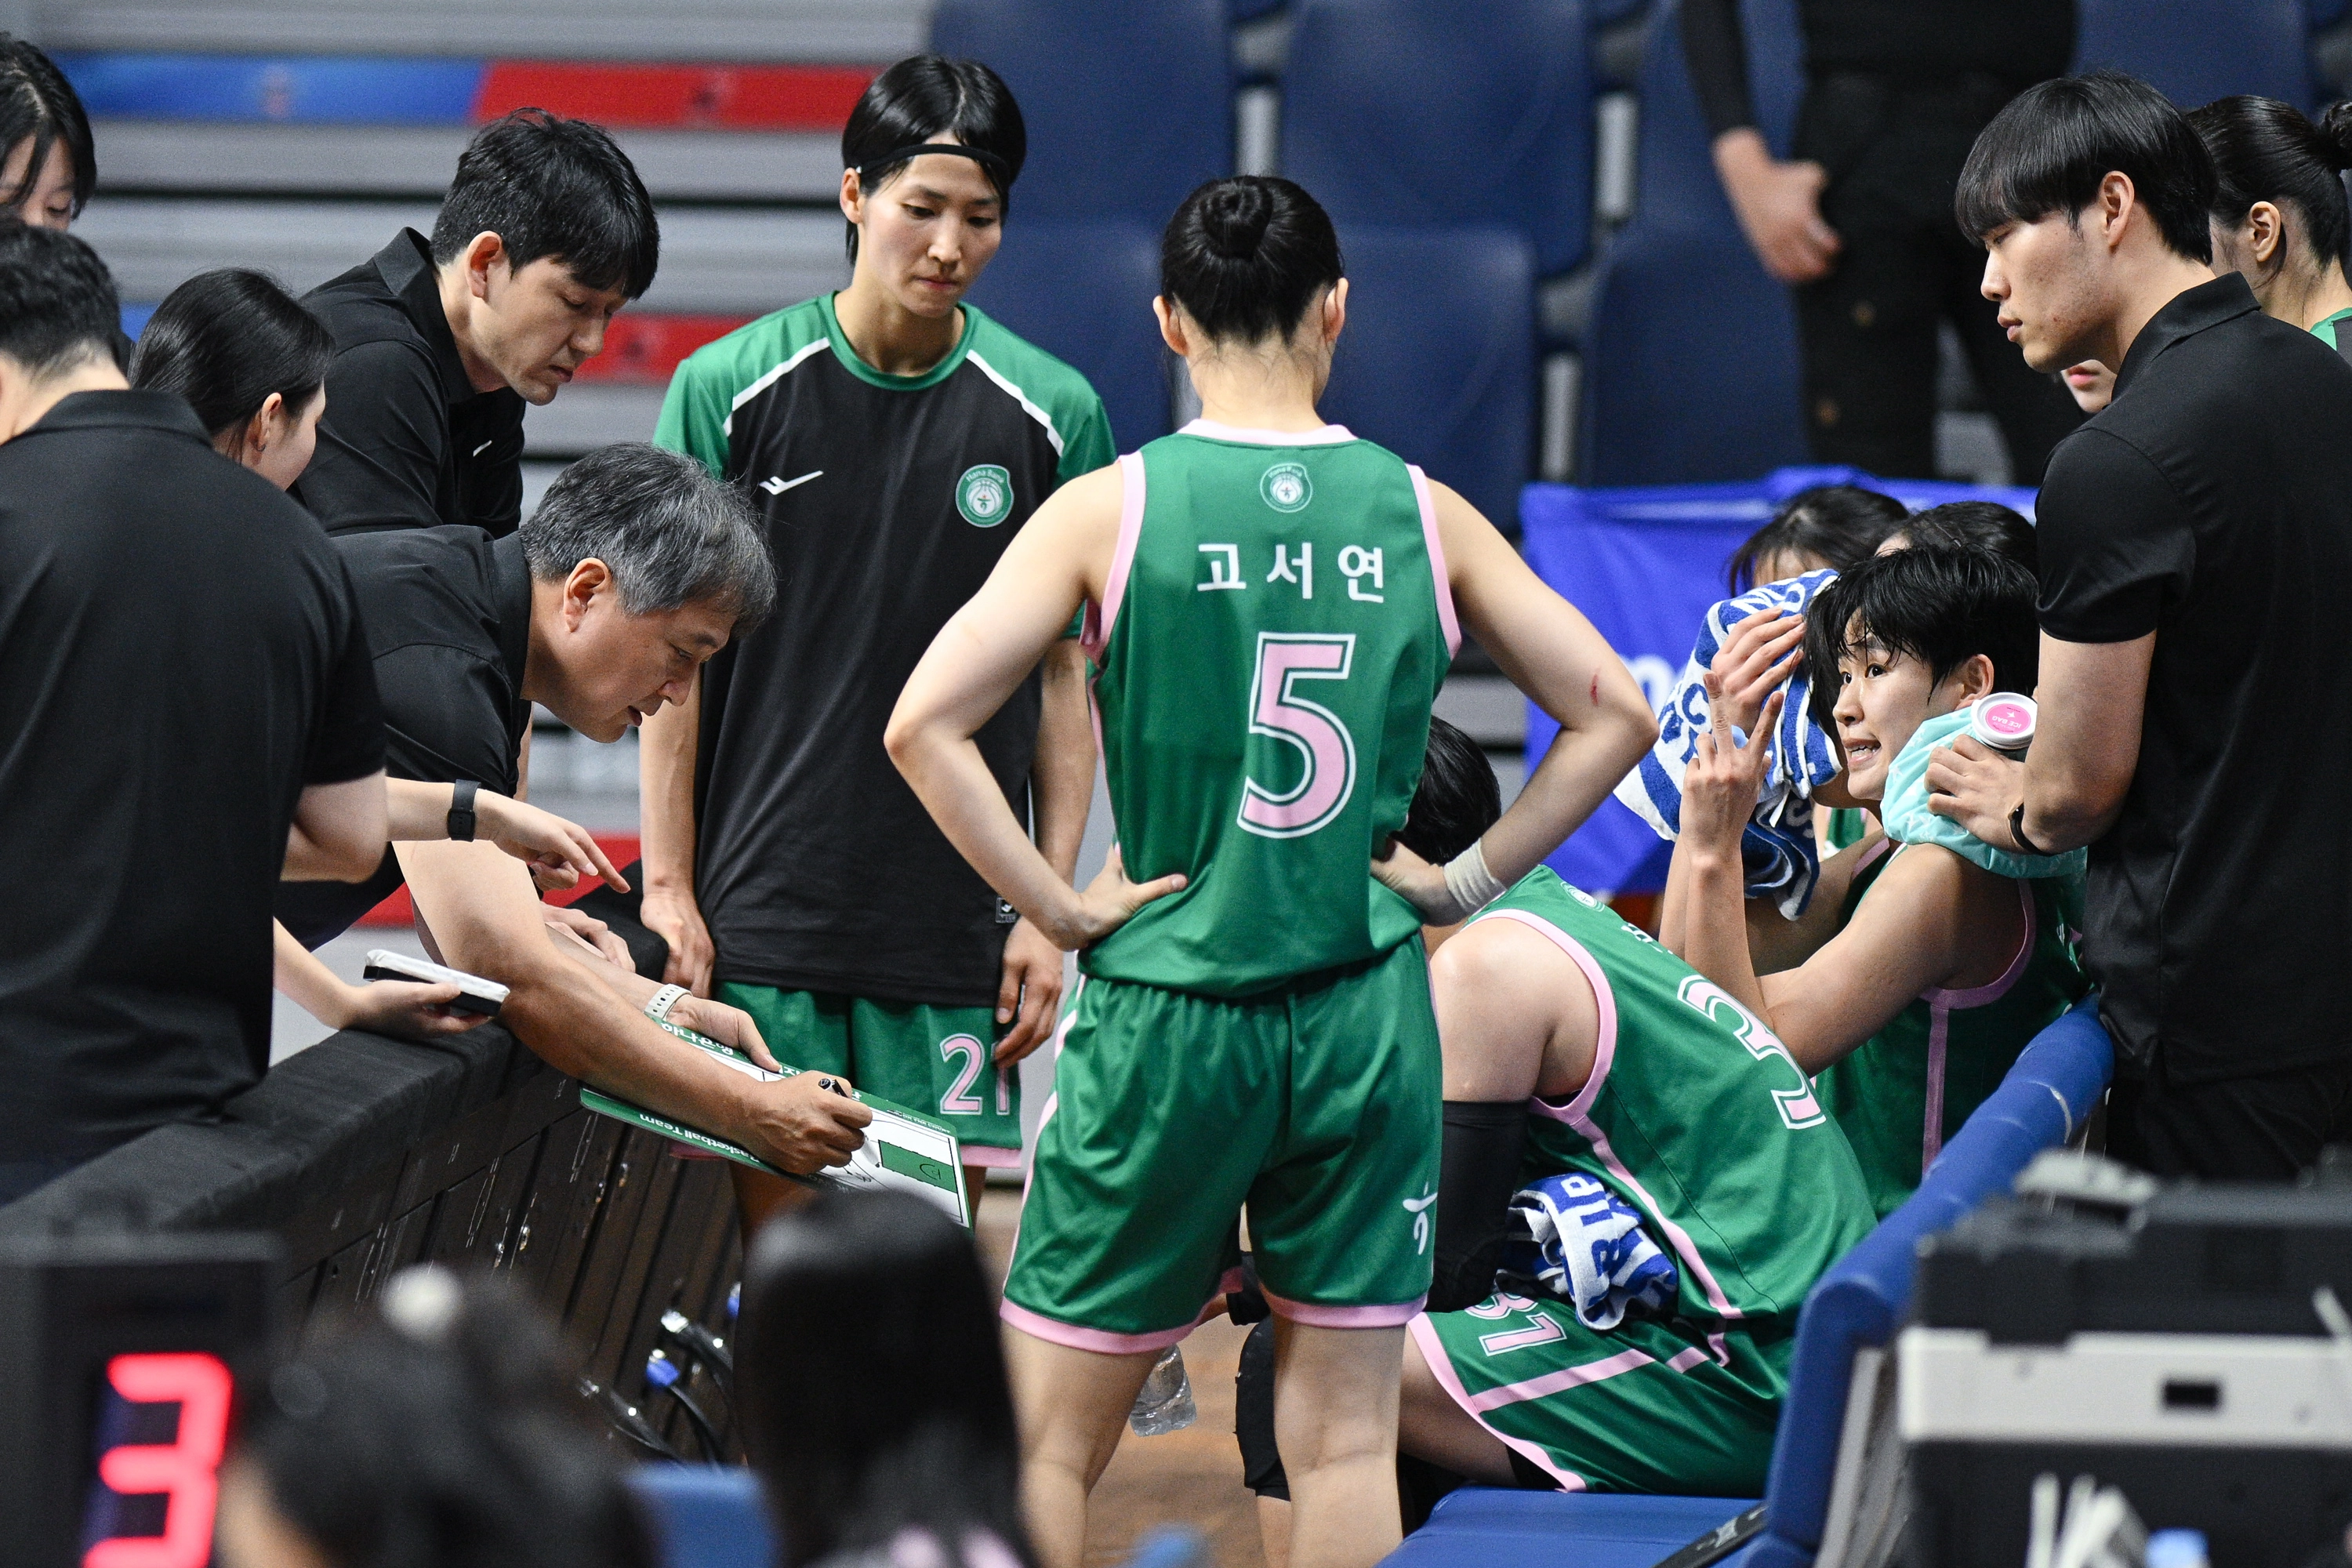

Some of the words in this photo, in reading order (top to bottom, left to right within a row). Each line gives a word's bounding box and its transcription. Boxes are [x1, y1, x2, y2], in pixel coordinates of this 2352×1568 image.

[1197, 542, 1384, 603] 고서연
[1237, 631, 1356, 839] 5
[1991, 715, 2008, 724] BAG
[2009, 720, 2022, 729] ICE
[639, 1113, 683, 1135] Team
[84, 1353, 232, 1568] 3
